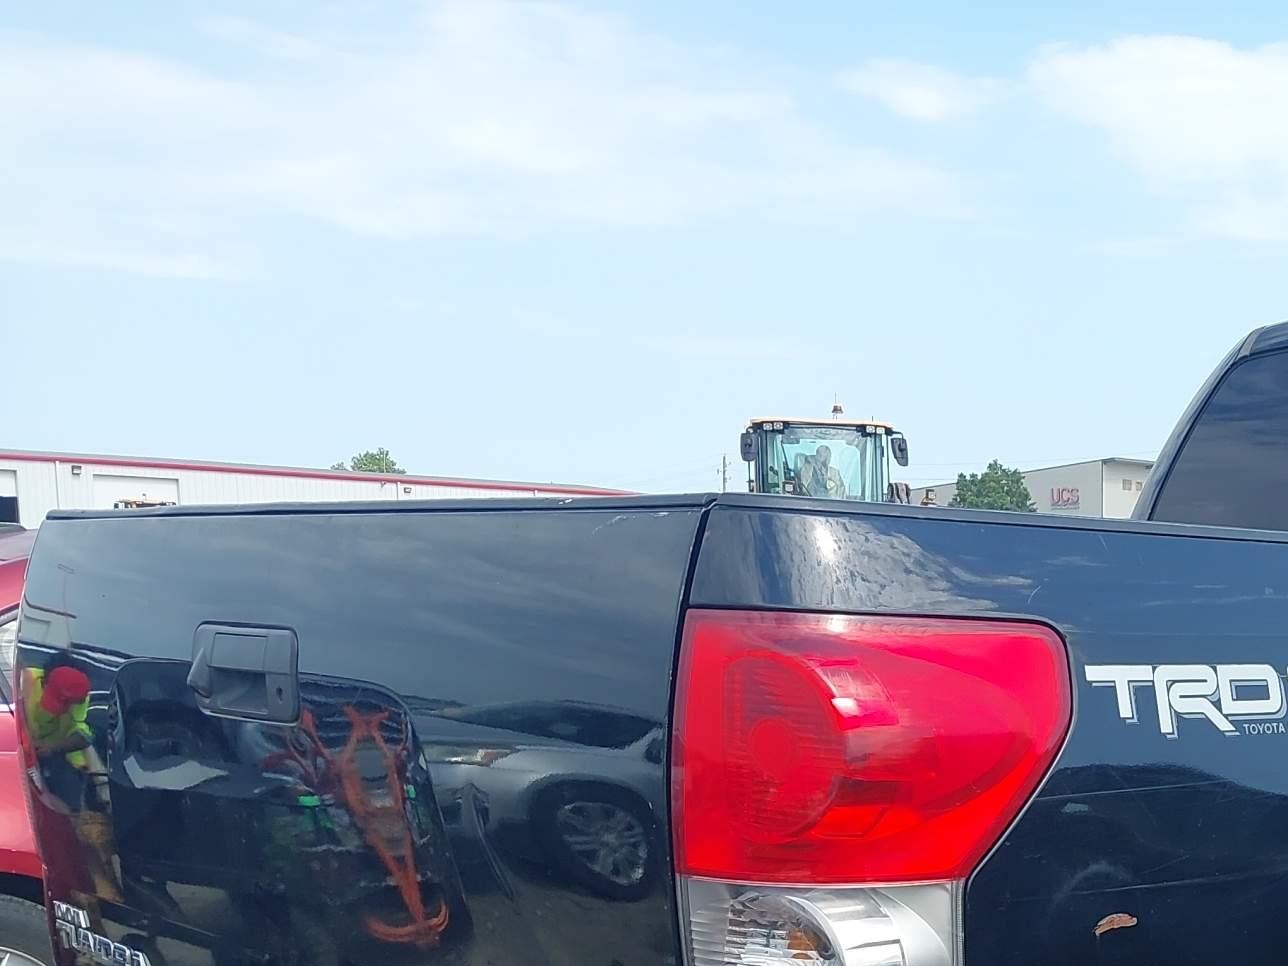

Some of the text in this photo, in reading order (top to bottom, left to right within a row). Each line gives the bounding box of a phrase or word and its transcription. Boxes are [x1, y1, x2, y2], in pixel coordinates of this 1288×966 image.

[1050, 487, 1080, 505] UCS
[1084, 663, 1287, 739] TRD
[1243, 721, 1286, 735] TOYOTA
